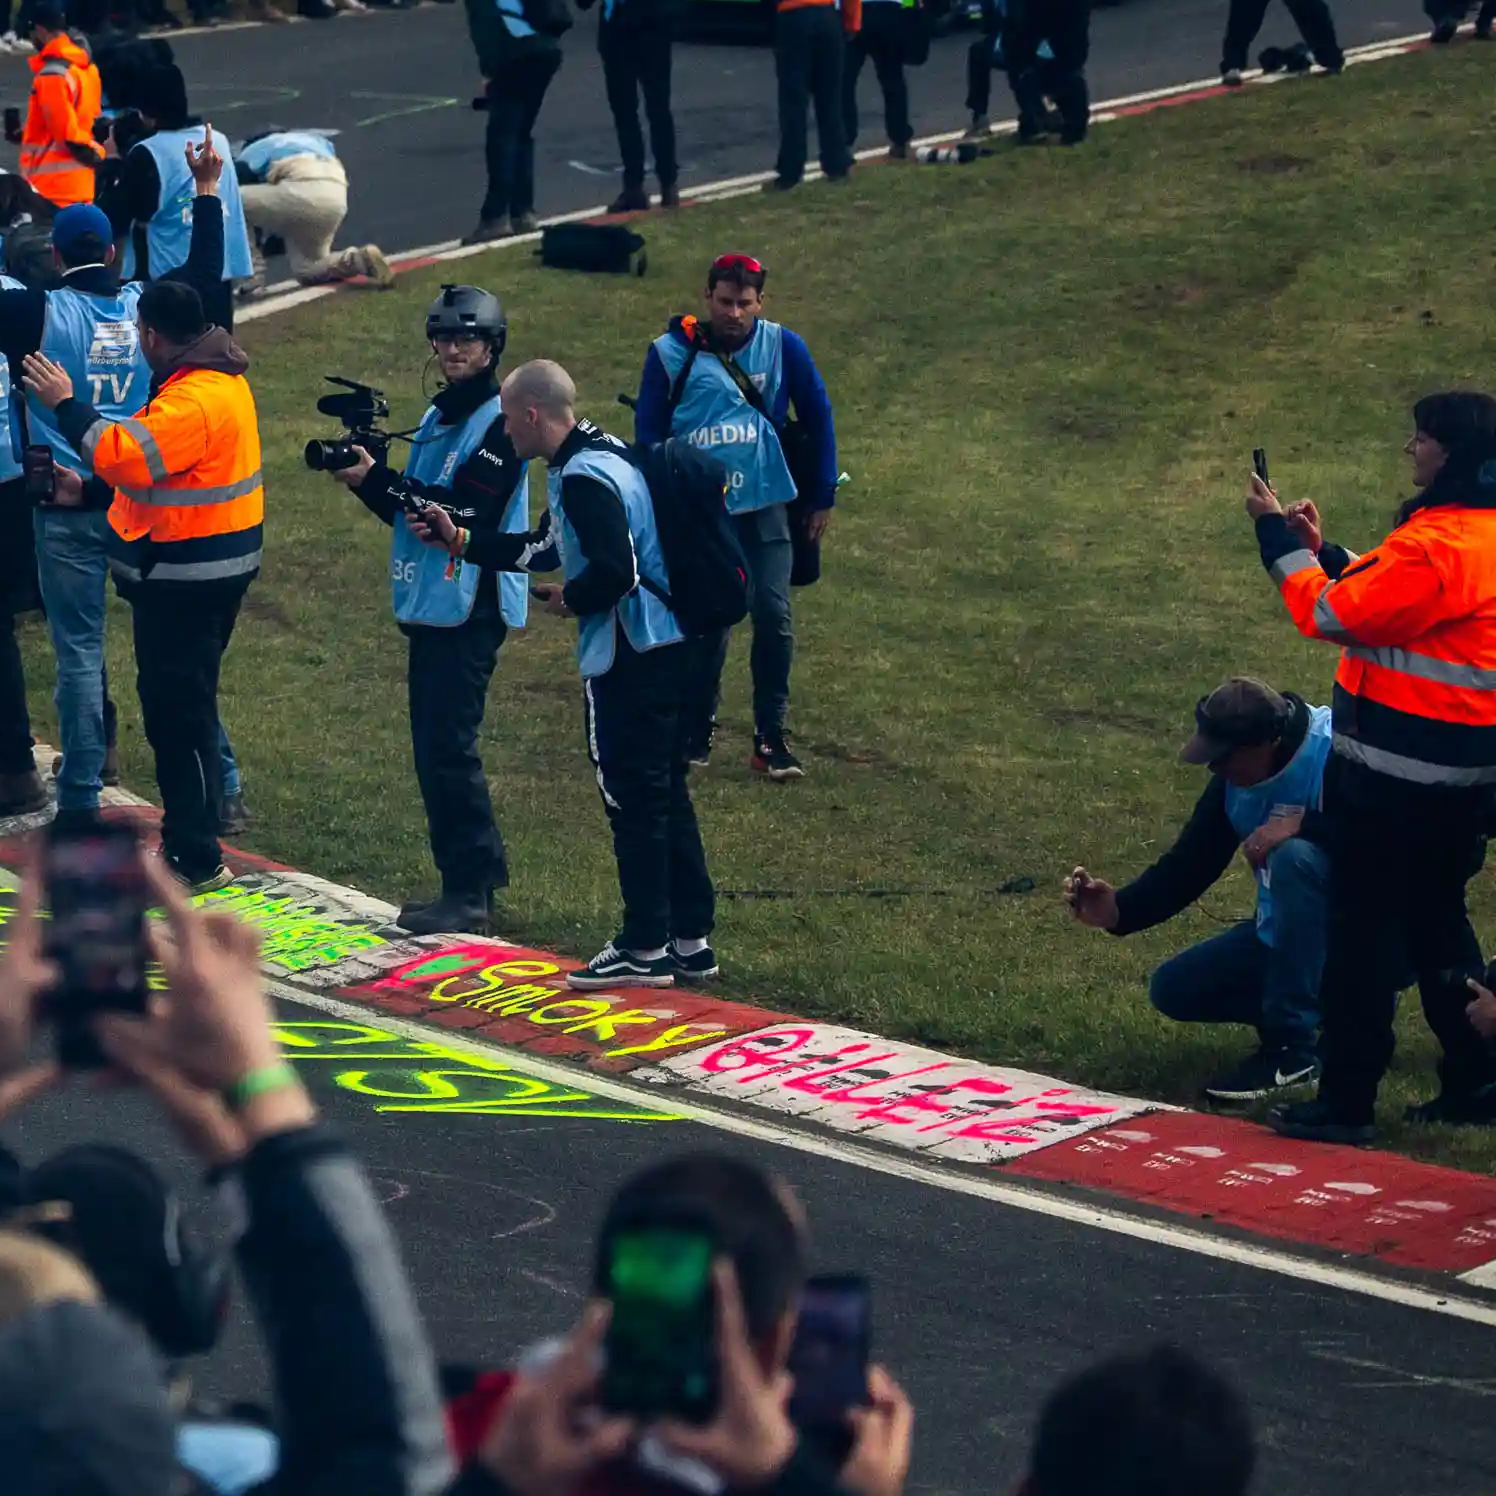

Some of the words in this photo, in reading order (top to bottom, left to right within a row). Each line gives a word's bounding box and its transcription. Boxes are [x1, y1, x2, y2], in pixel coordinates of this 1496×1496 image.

[86, 371, 135, 405] TV
[689, 422, 758, 449] MEDIA
[478, 447, 504, 467] Ansys
[391, 558, 417, 583] 36
